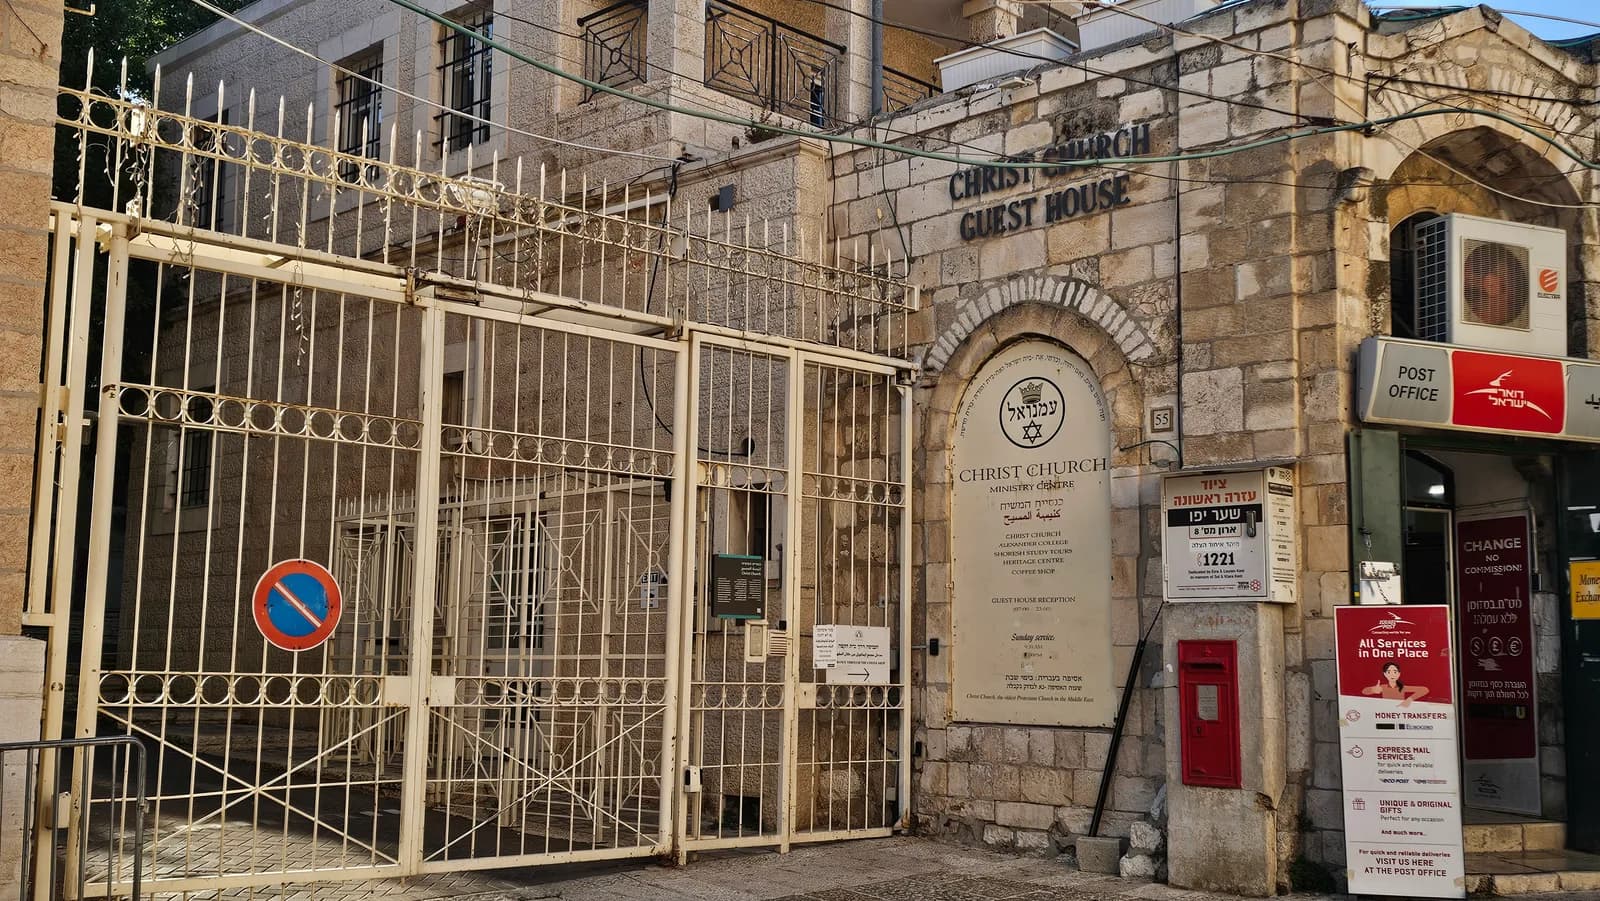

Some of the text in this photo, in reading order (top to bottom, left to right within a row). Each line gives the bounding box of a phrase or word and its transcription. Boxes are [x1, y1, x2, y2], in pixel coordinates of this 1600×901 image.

[949, 123, 1150, 200] CHRIST CHURCH
[959, 173, 1131, 241] GUEST HOUSE
[1398, 366, 1436, 382] POST
[1388, 384, 1439, 402] OFFICE
[1488, 395, 1527, 408] ישראל
[1007, 400, 1058, 422] עמנואל
[1154, 414, 1169, 426] 55
[959, 458, 1107, 483] CHRIST CHURCH
[989, 480, 1075, 493] MINISTRY CENTRE
[1200, 479, 1227, 490] ציוד
[1173, 490, 1256, 506] עזרה ראשונה
[1000, 501, 1031, 511] המשיח
[1189, 508, 1241, 522] שער יפו
[1005, 532, 1029, 540] CHRIST
[1219, 526, 1237, 536] ארון
[1463, 538, 1522, 552] CHANGE
[1037, 557, 1065, 565] CENTRE
[1203, 552, 1235, 566] 1221
[1485, 554, 1500, 562] NO
[1464, 564, 1523, 574] COMMISSION!
[1011, 632, 1033, 643] Sunday
[1359, 638, 1427, 648] All Services
[1358, 648, 1429, 658] in One Place
[1377, 746, 1411, 754] EXPRESS
[1379, 799, 1408, 807] UNIQUE
[1417, 801, 1452, 809] ORIGINAL
[1398, 858, 1410, 866] US
[1411, 859, 1434, 867] HERE
[1376, 867, 1392, 875] THE
[1394, 868, 1415, 876] POST
[1417, 869, 1447, 877] OFFICE
